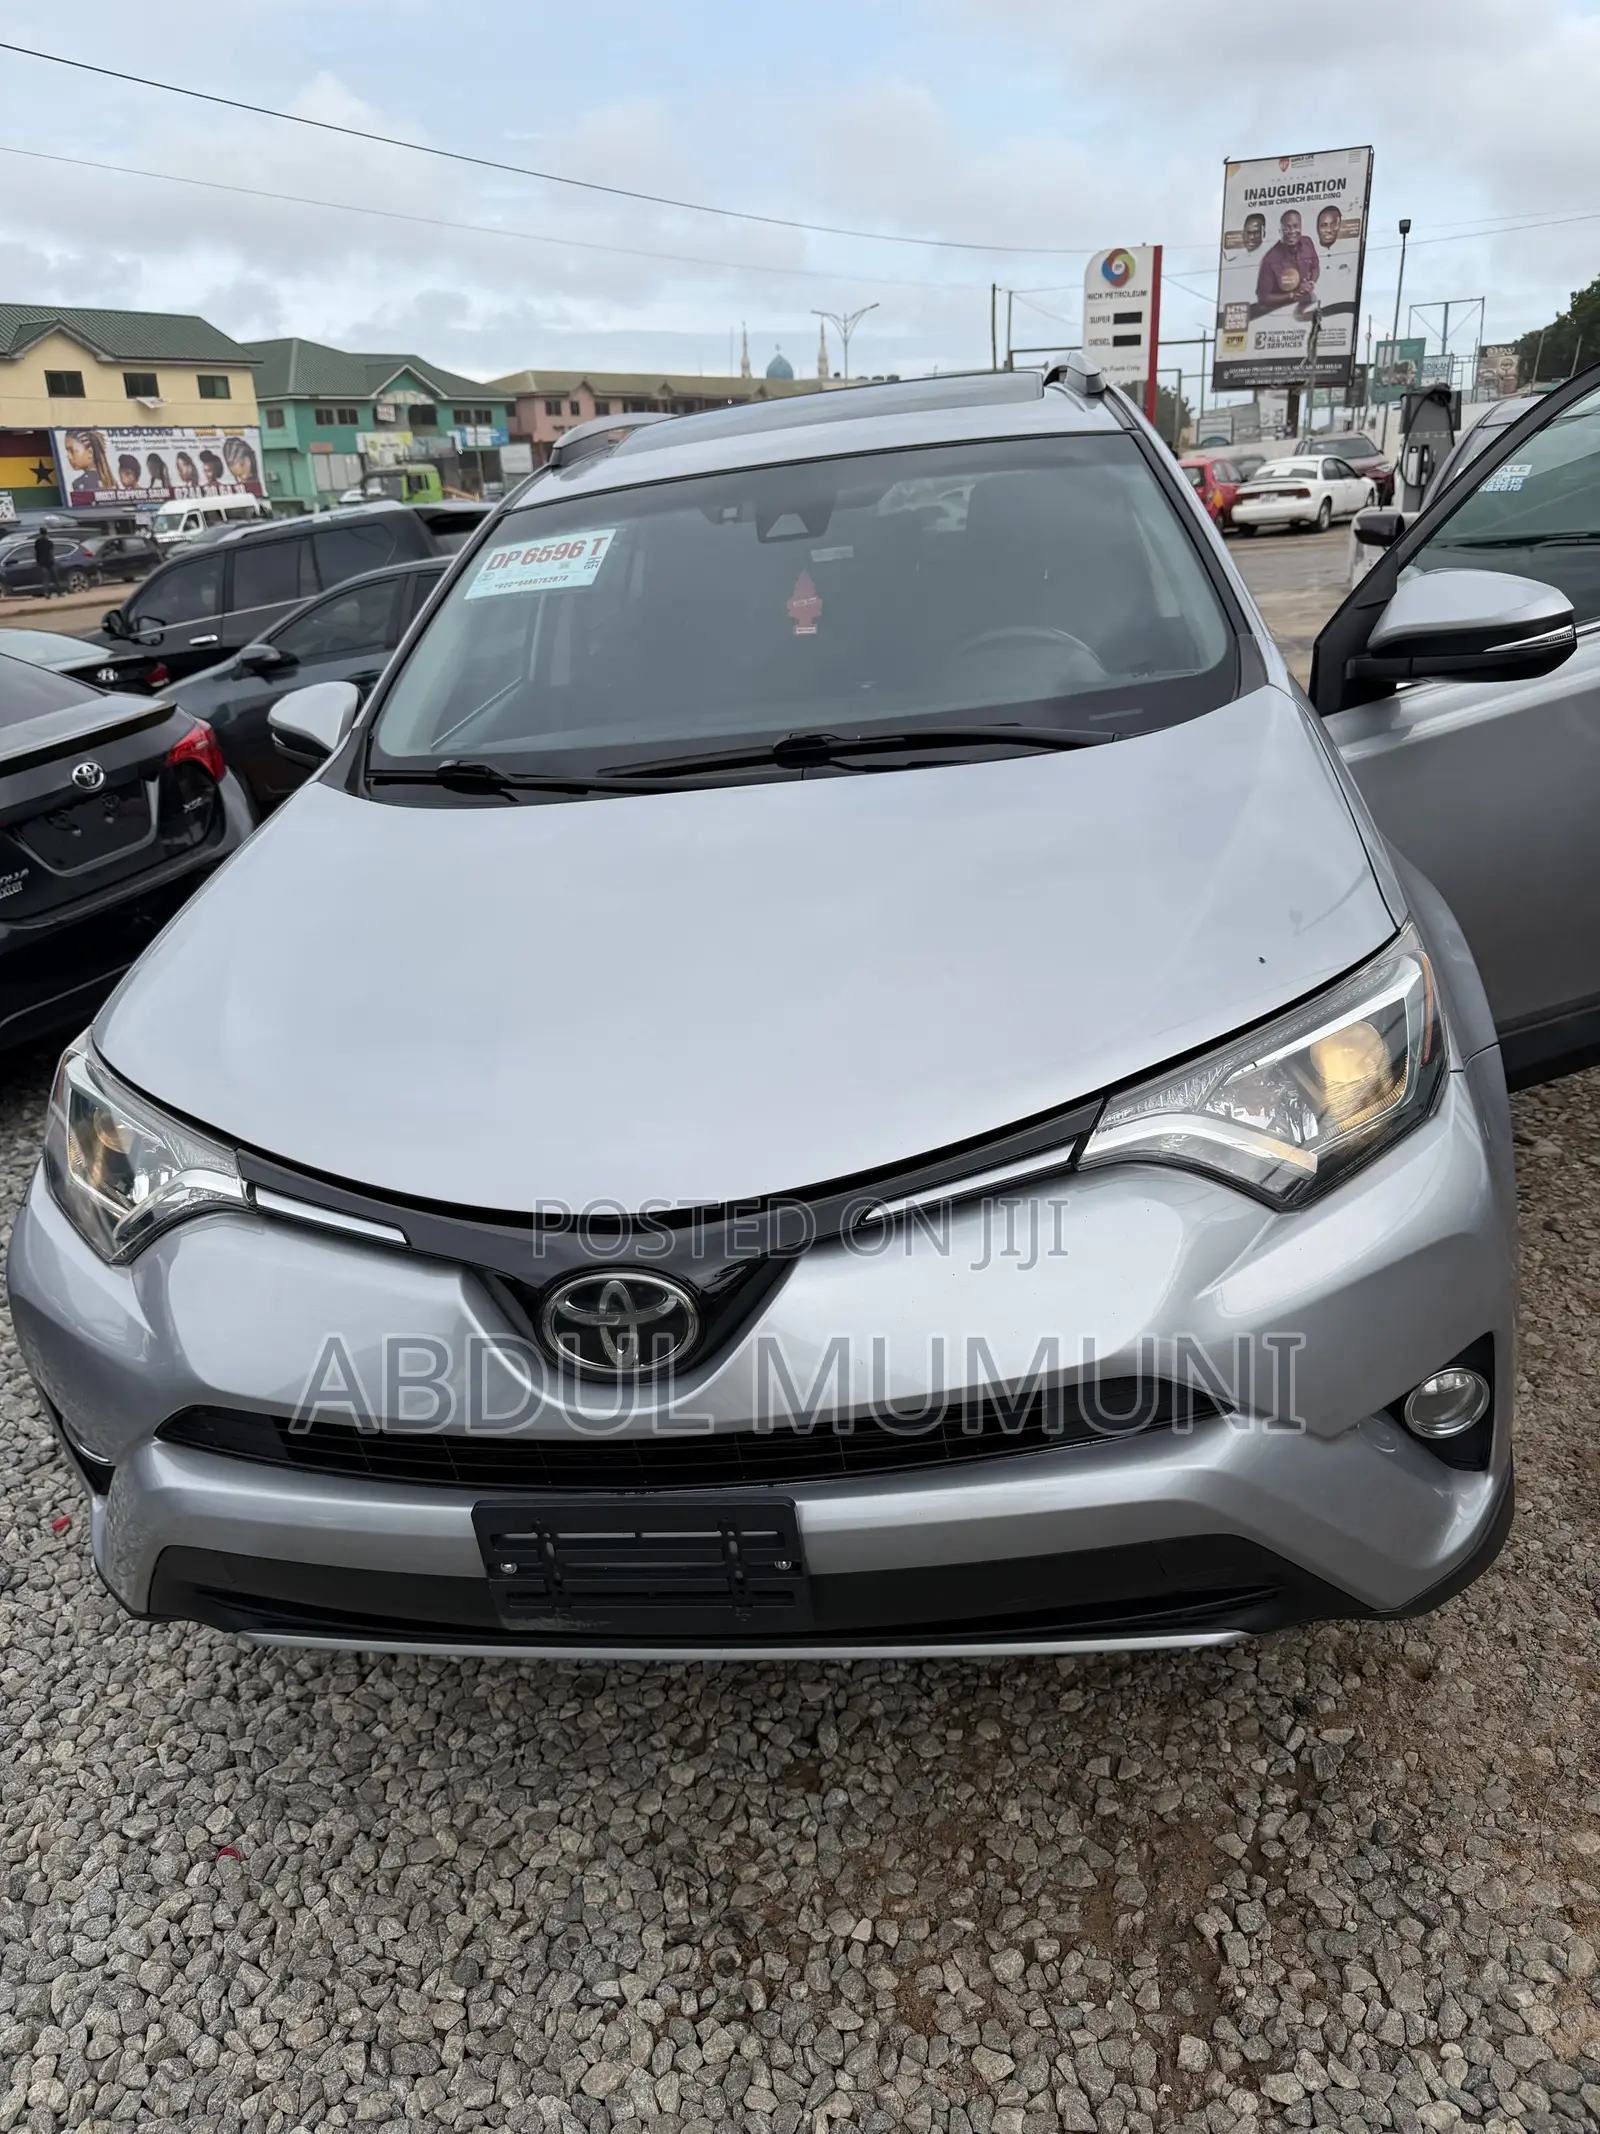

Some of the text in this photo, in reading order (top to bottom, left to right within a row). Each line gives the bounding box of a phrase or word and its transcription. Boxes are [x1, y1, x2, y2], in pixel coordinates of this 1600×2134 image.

[1244, 177, 1347, 201] INAUGURATION
[1248, 191, 1341, 208] OF NEW CHURCH BUILDING
[1105, 290, 1147, 300] PETROLEUM
[486, 536, 609, 571] DP 6596 T
